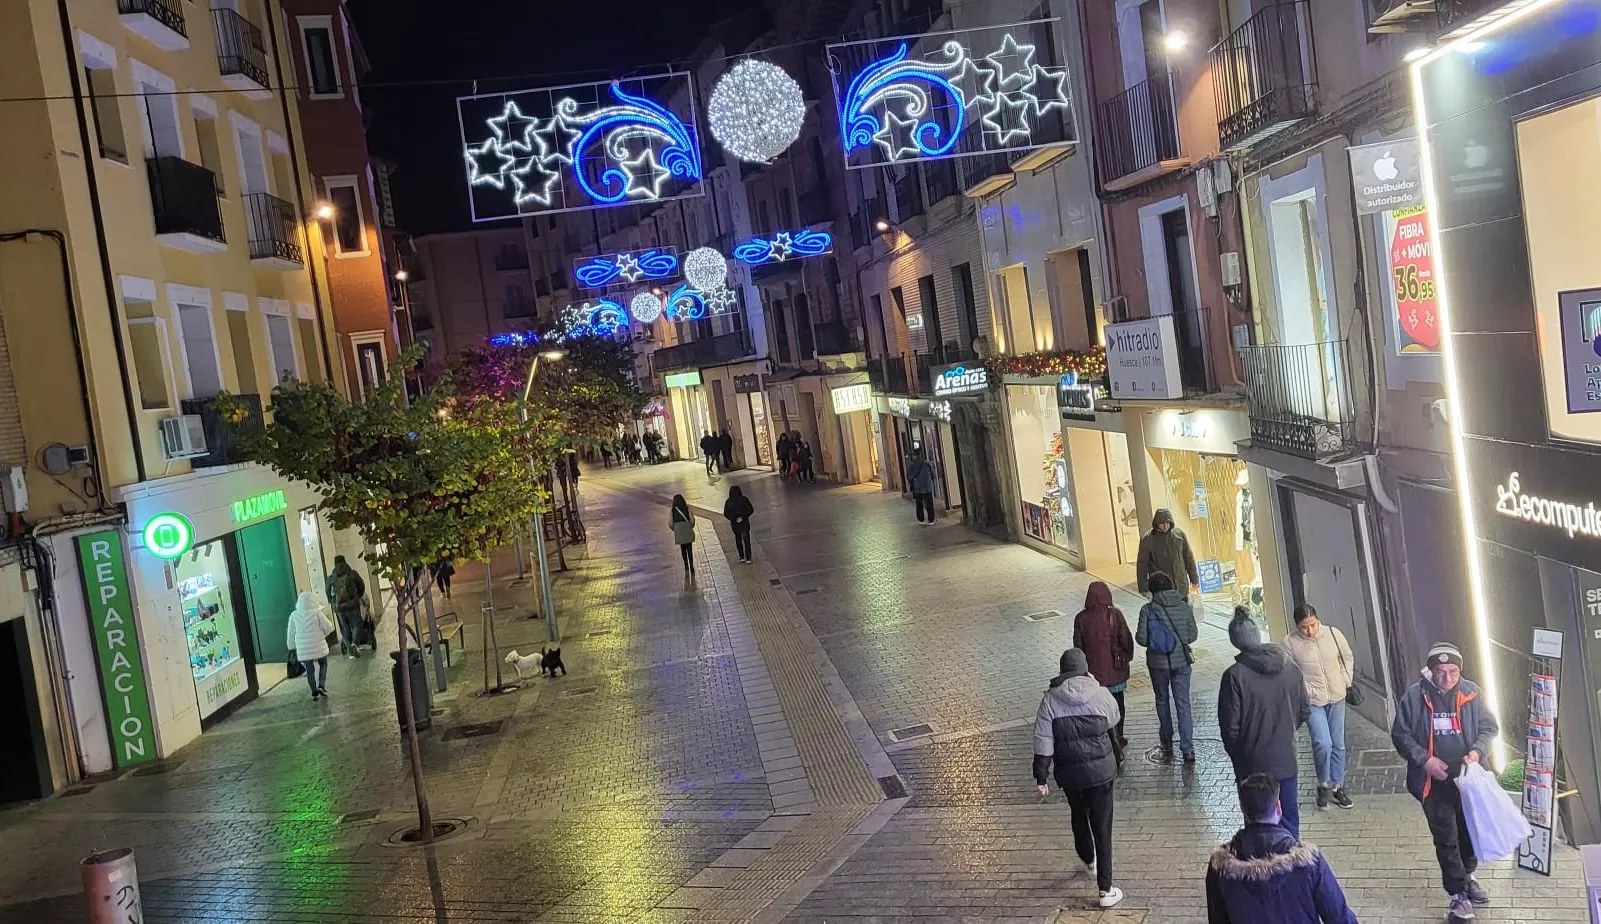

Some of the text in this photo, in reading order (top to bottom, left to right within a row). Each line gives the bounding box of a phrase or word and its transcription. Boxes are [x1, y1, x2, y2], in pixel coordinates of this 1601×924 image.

[1363, 181, 1415, 195] Distribuidor
[1367, 193, 1413, 207] autorizado
[1399, 221, 1425, 240] FIBRA
[1116, 328, 1159, 353] hitradio
[935, 371, 987, 390] Arenas
[91, 541, 145, 760] REPARACION
